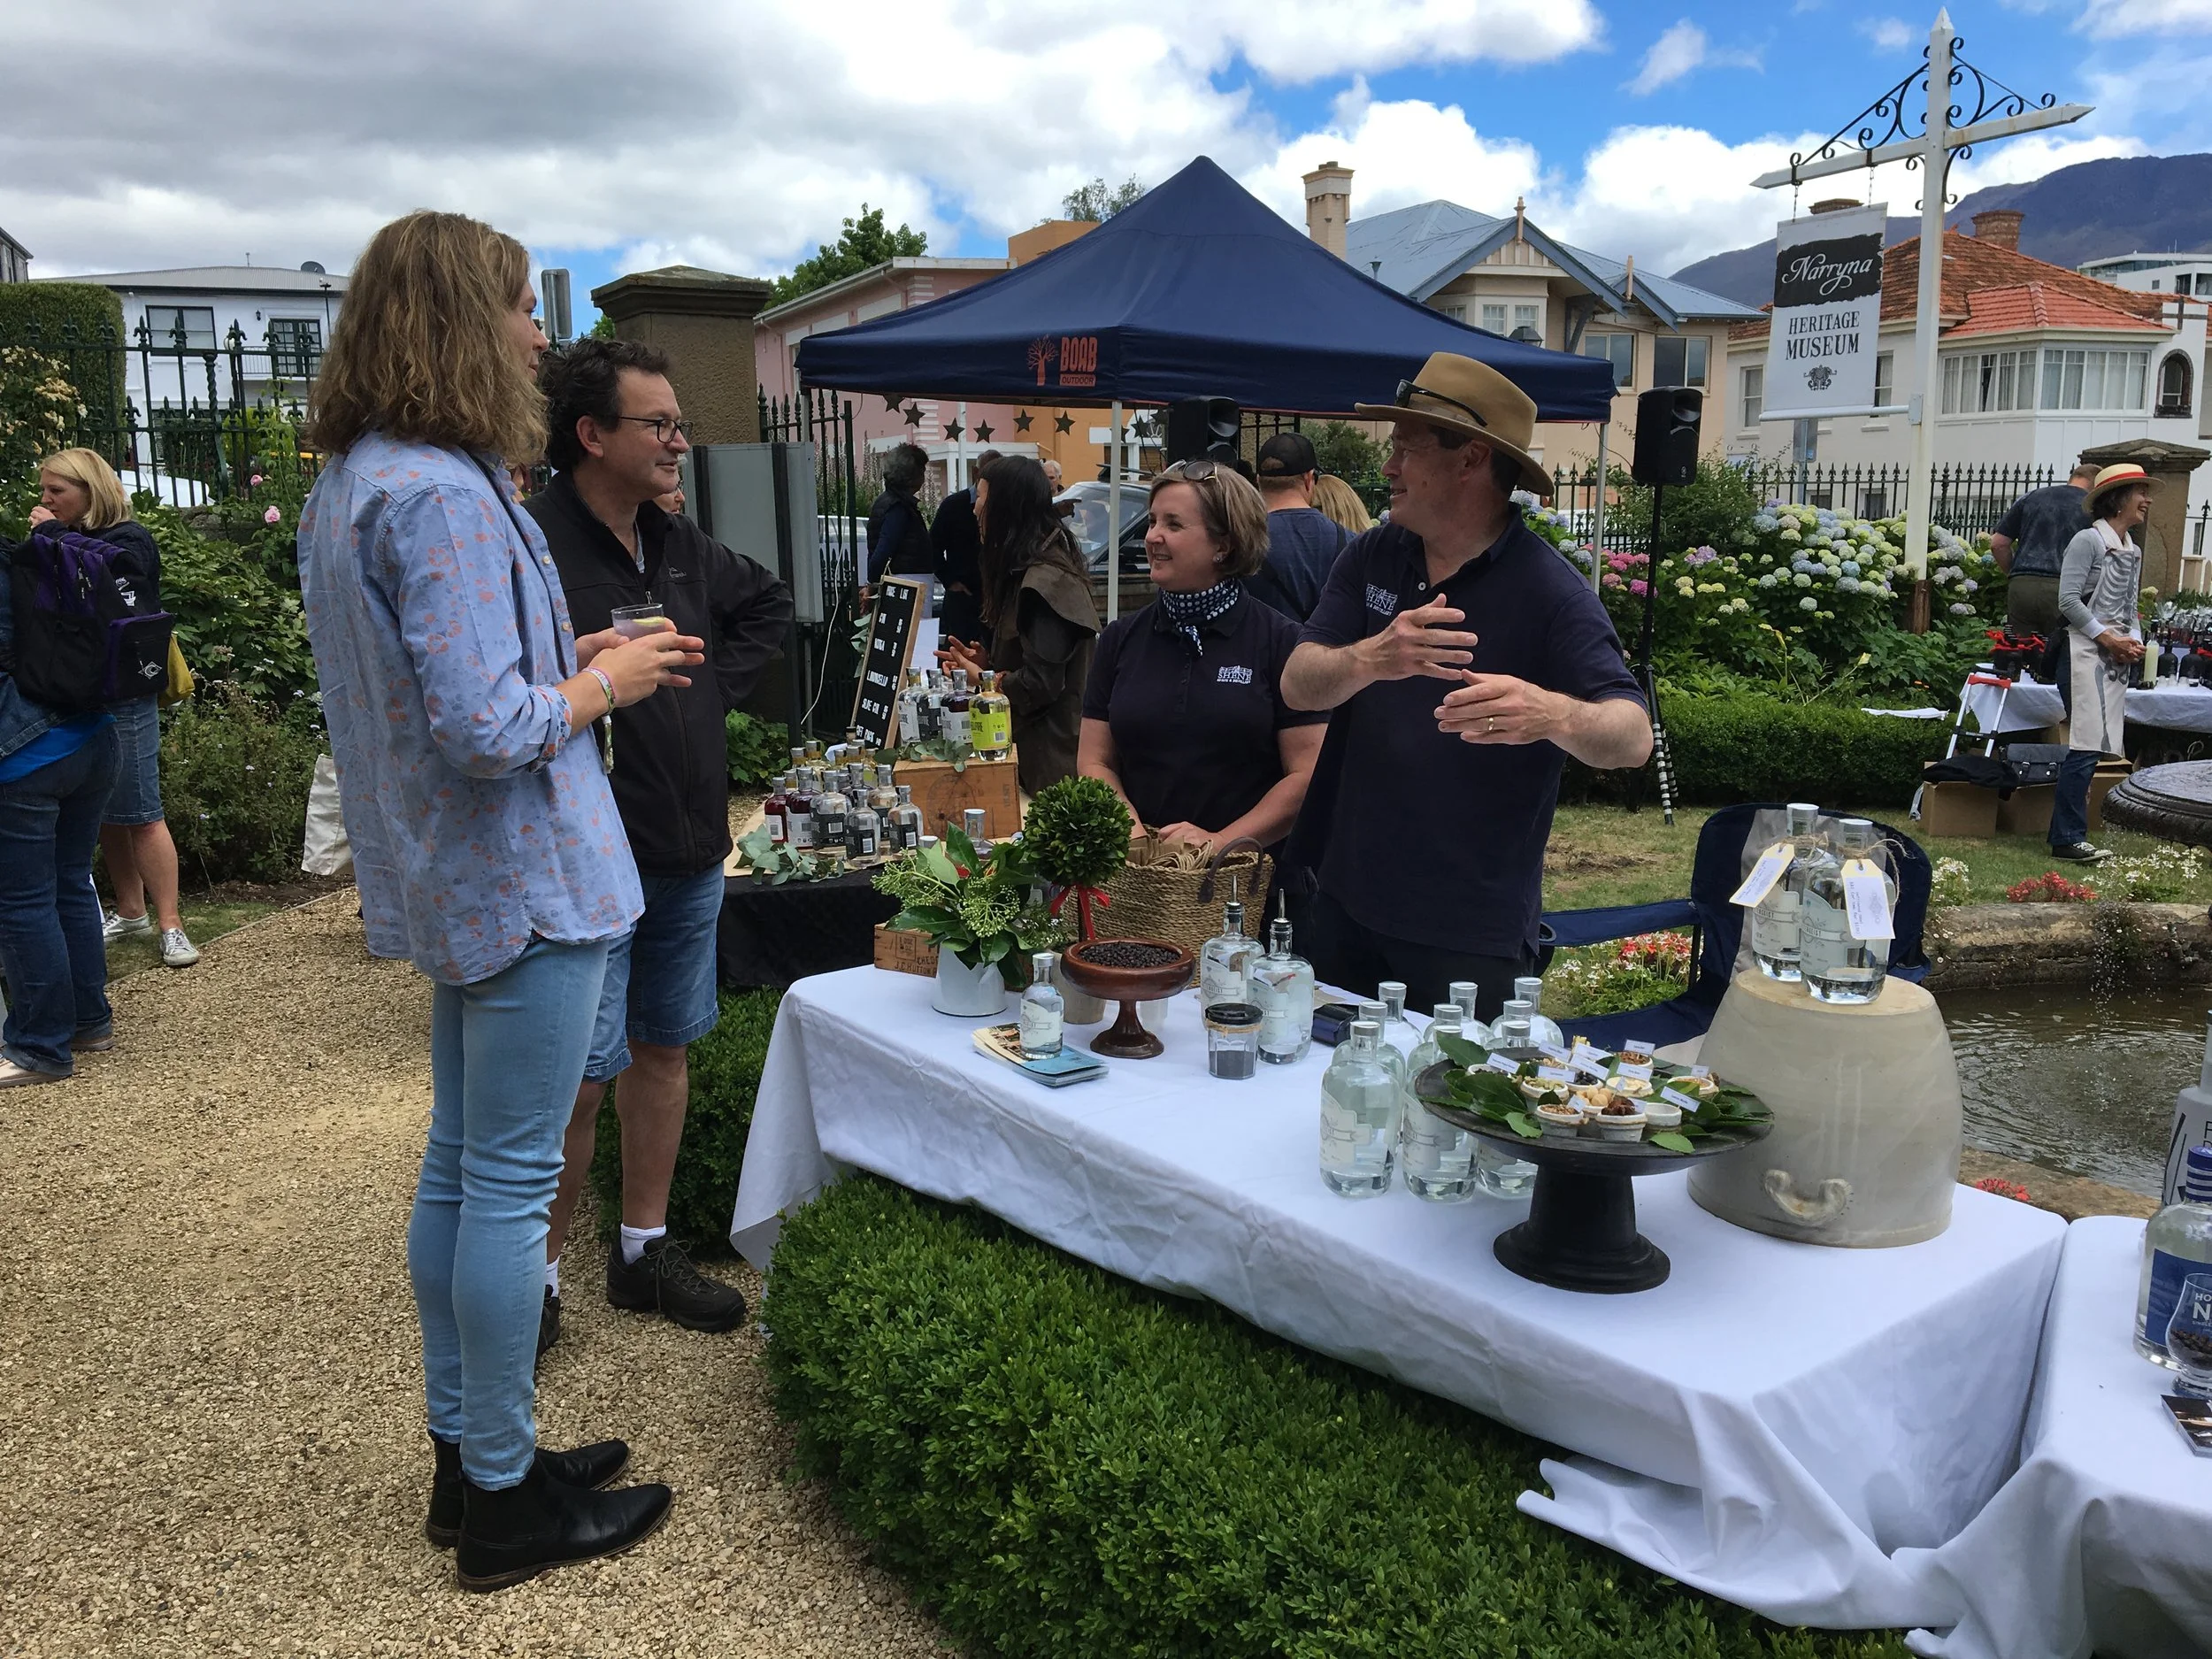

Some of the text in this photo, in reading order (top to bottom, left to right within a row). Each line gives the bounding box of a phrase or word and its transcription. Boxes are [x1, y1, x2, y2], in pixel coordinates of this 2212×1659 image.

[1782, 253, 1874, 296] Narryna
[1788, 311, 1861, 334] HERITAGE
[1061, 336, 1098, 372] BOAB
[1786, 333, 1861, 360] MUSEUM
